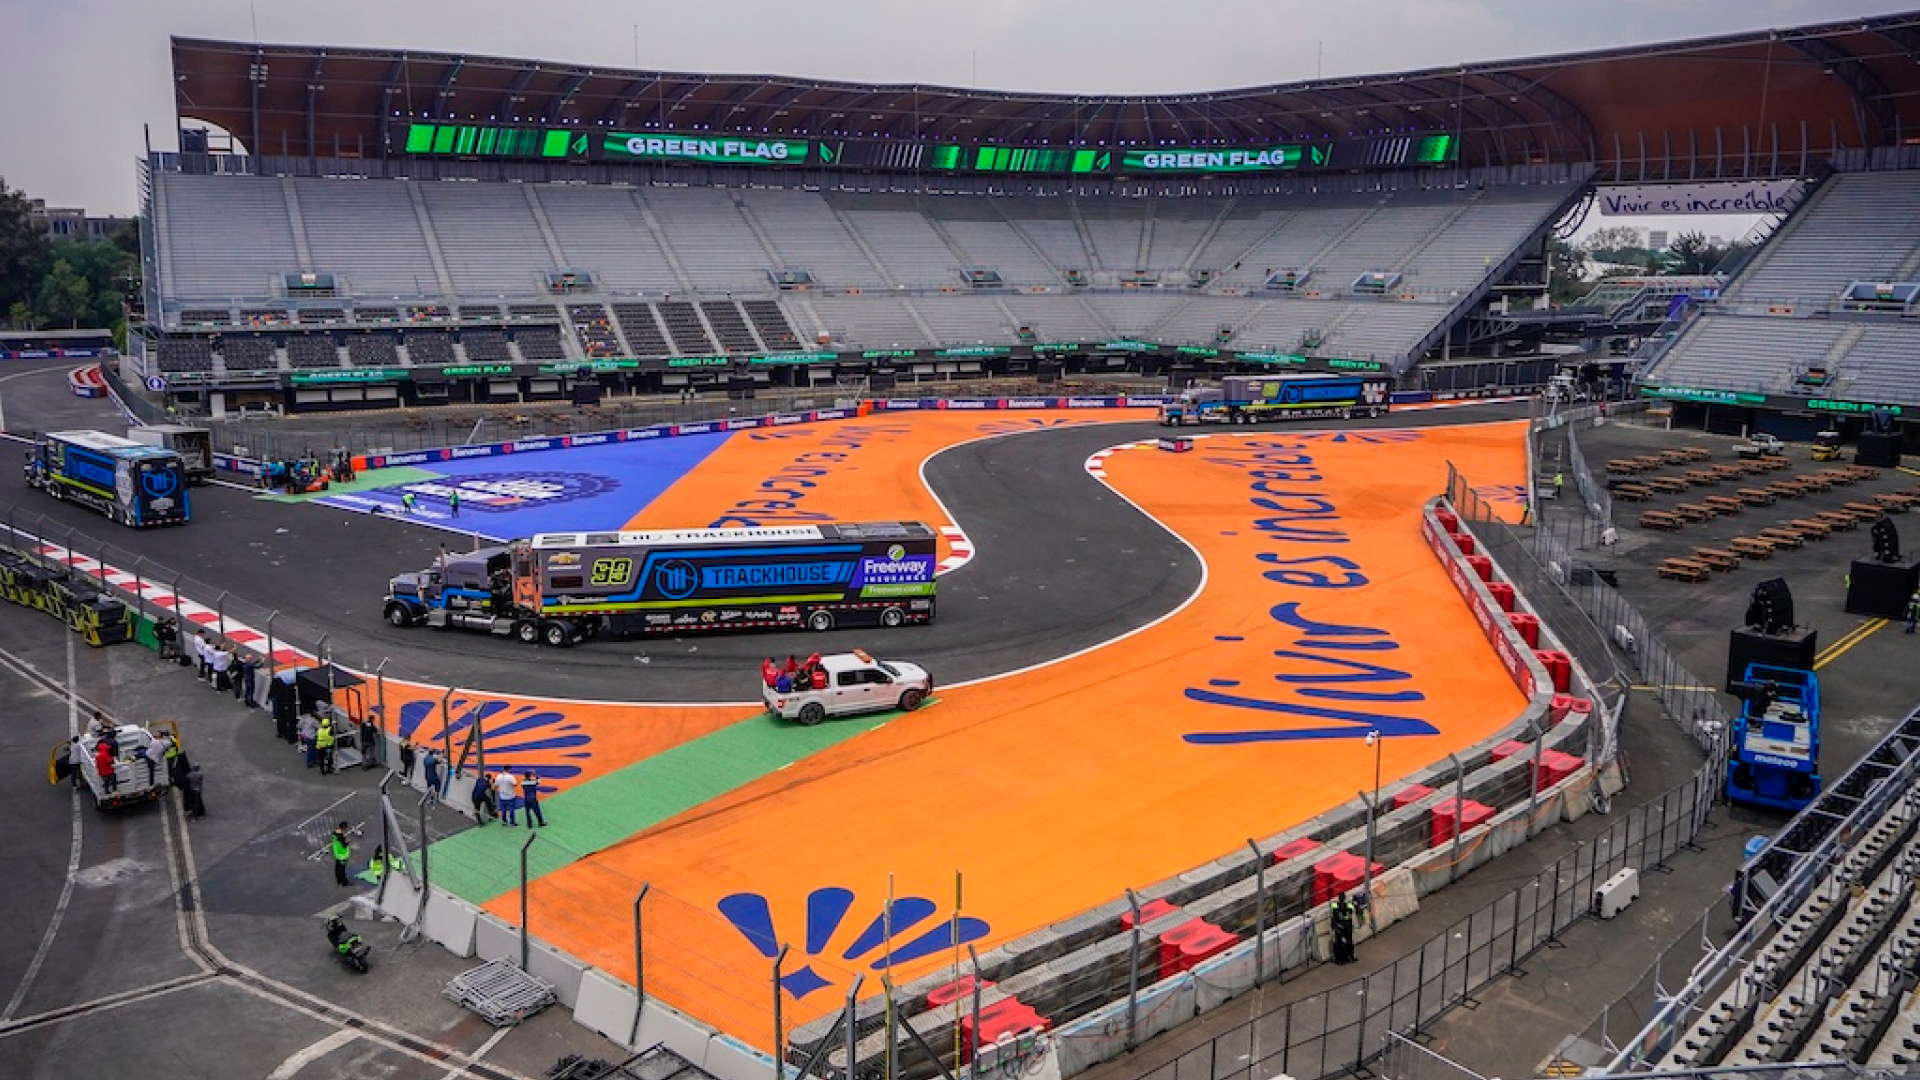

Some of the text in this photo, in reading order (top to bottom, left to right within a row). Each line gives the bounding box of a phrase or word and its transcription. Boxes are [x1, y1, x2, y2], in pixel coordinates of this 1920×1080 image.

[627, 136, 789, 160] GREEN FLAG
[1143, 149, 1285, 168] GREEN FLAG
[1607, 194, 1651, 212] Vivir
[1661, 199, 1679, 212] es
[1659, 385, 1737, 401] GREEN FLAG
[627, 429, 661, 439] Banamex
[679, 424, 711, 433] Banamex
[513, 441, 550, 451] Banamex
[572, 435, 608, 446] Banamex
[385, 453, 428, 465] Banamex
[451, 447, 492, 458] Banamex
[590, 557, 633, 586] 99
[712, 564, 831, 585] TRACKHOUSE
[864, 559, 927, 576] Freeway
[1255, 553, 1370, 588] es
[868, 585, 923, 596] Freeway.com
[1182, 602, 1441, 745] Vivir
